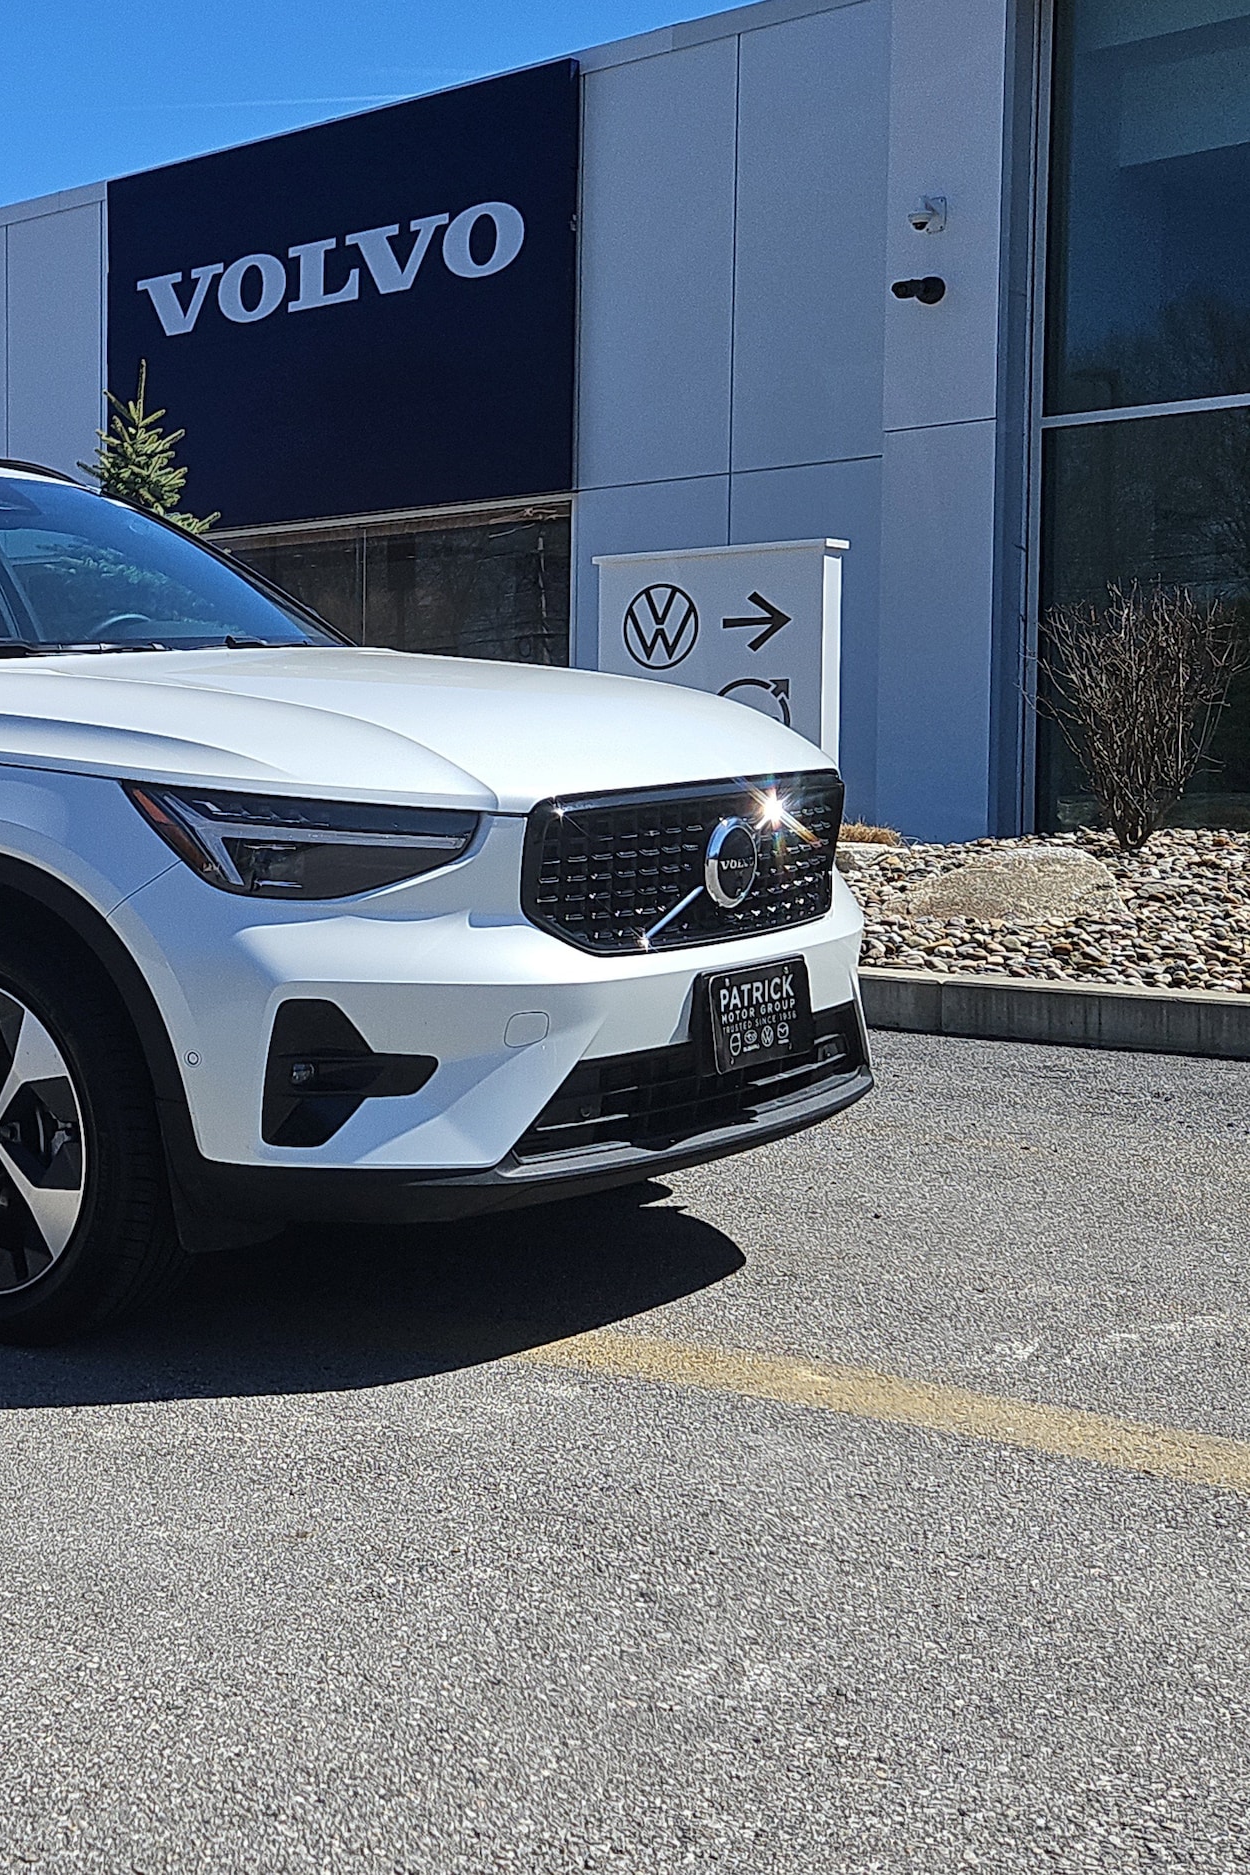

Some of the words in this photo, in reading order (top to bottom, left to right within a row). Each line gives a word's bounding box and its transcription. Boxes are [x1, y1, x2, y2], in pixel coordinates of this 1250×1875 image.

[137, 201, 524, 336] VOLVO
[720, 974, 794, 1012] PATRICK
[721, 1007, 755, 1025] MOTOR
[760, 998, 796, 1015] GROUP
[723, 1020, 753, 1035] TRUSTED
[755, 1014, 776, 1027] SINCE
